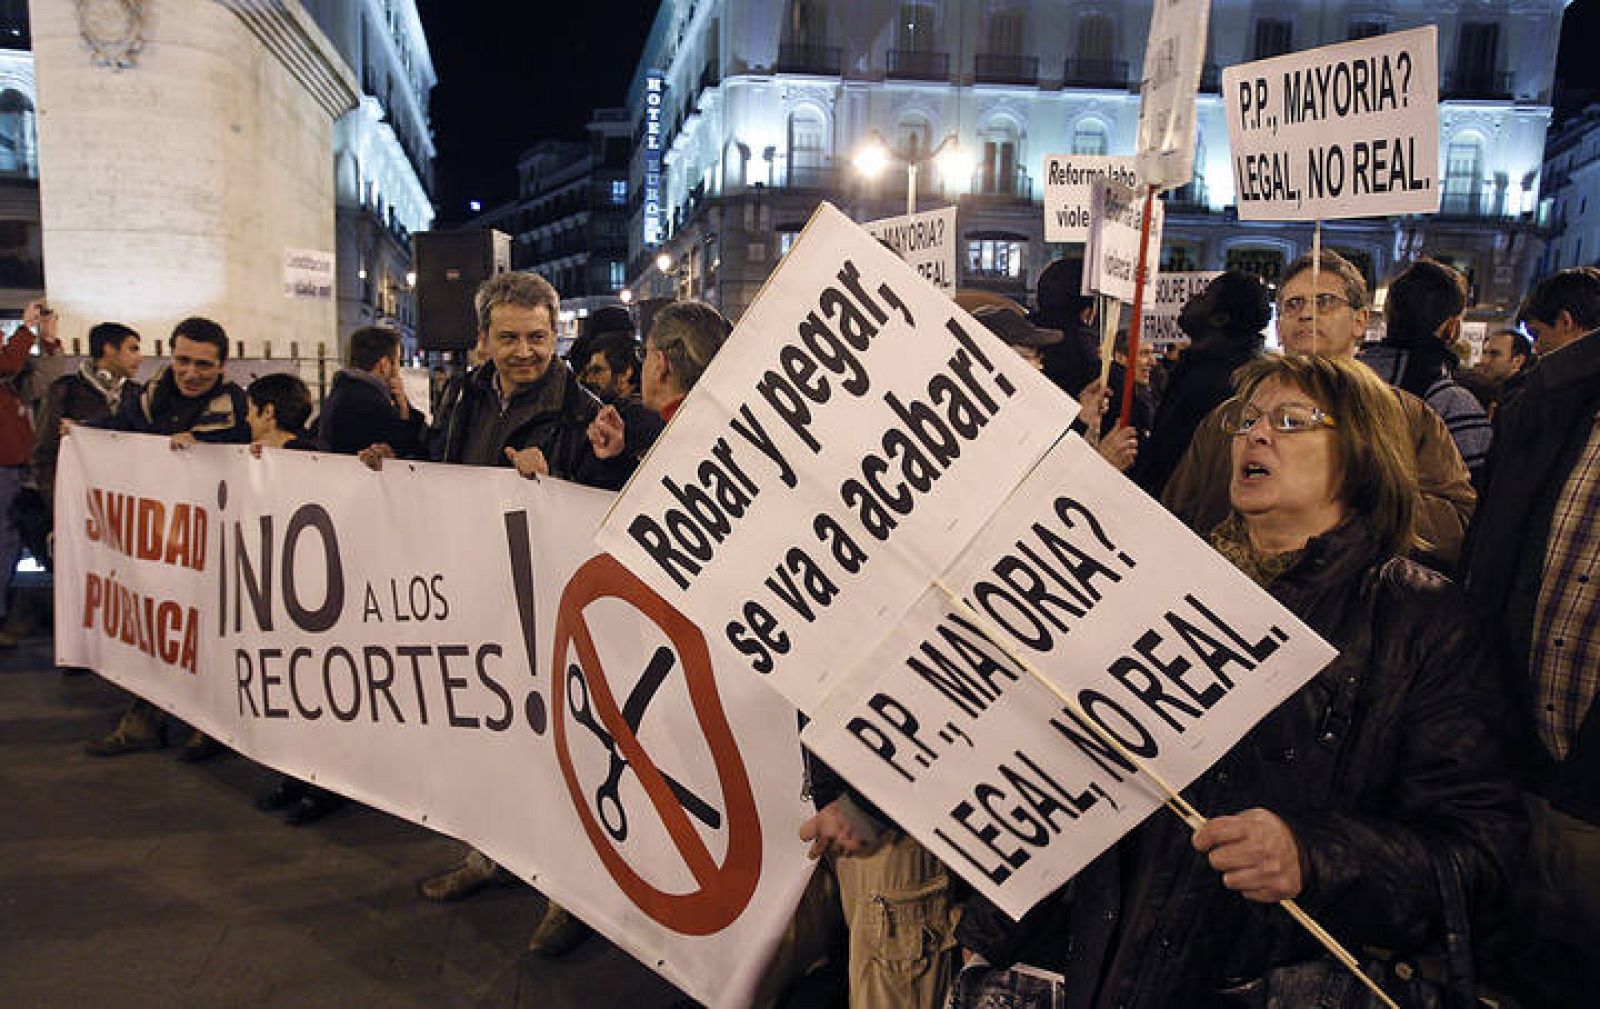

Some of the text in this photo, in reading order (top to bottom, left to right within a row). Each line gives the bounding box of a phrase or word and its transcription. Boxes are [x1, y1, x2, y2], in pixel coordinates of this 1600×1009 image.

[646, 78, 661, 150] HOTEL
[1239, 78, 1278, 136] P.P.,
[1284, 50, 1412, 125] MAYORIA?
[1237, 137, 1431, 208] LEGAL, NO REAL.
[626, 258, 916, 592] Robar y pegar,
[86, 488, 208, 571] SNIDAD
[725, 317, 1017, 674] se va a acabar!
[362, 581, 384, 624] A
[390, 573, 451, 623] LOS
[845, 496, 1138, 784] P.P., MAYORIA?
[932, 593, 1290, 887] LEGAL, NO REAL.
